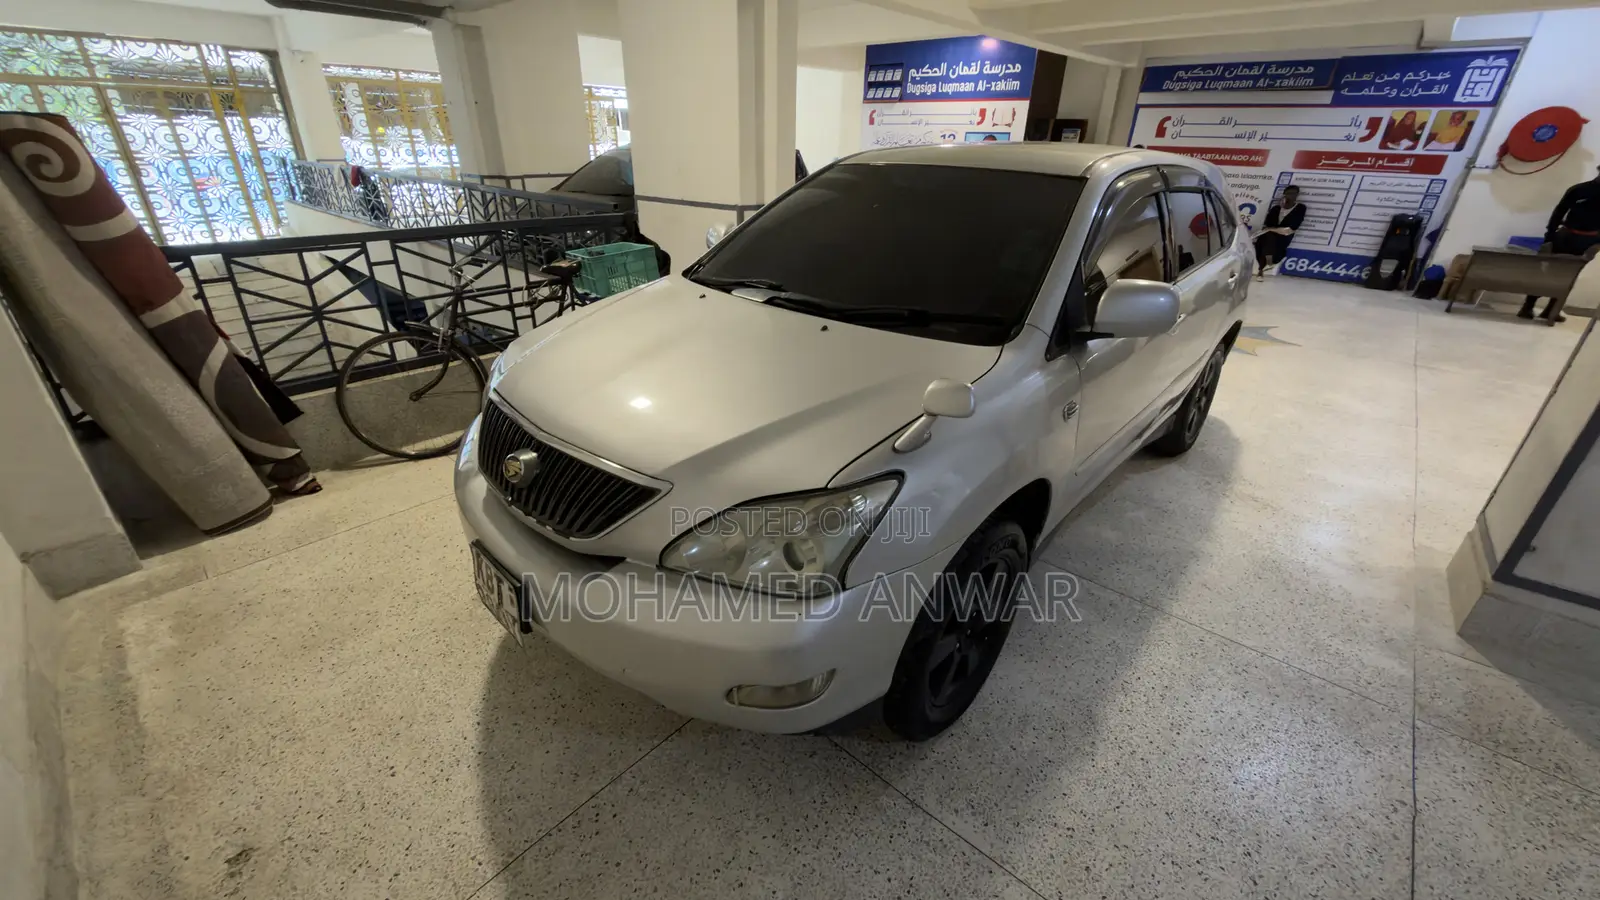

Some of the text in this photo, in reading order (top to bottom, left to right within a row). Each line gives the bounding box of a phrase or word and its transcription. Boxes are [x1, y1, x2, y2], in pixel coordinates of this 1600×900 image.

[908, 60, 1022, 82] مدرسة لقمان الحكيم
[1173, 64, 1315, 80] مدرسة لقمان الحكيم
[1341, 70, 1451, 84] خيركم من تعلم
[906, 81, 937, 96] Dugsiga
[938, 80, 975, 95] Luqmaan
[976, 79, 1020, 93] Al-xakiim
[1162, 77, 1315, 91] Dugsiga Luqmaan Al-xakiim
[1340, 83, 1450, 98] القرآن وعلمه
[1317, 155, 1416, 169] أقسام المركز
[1283, 257, 1372, 280] 6844446
